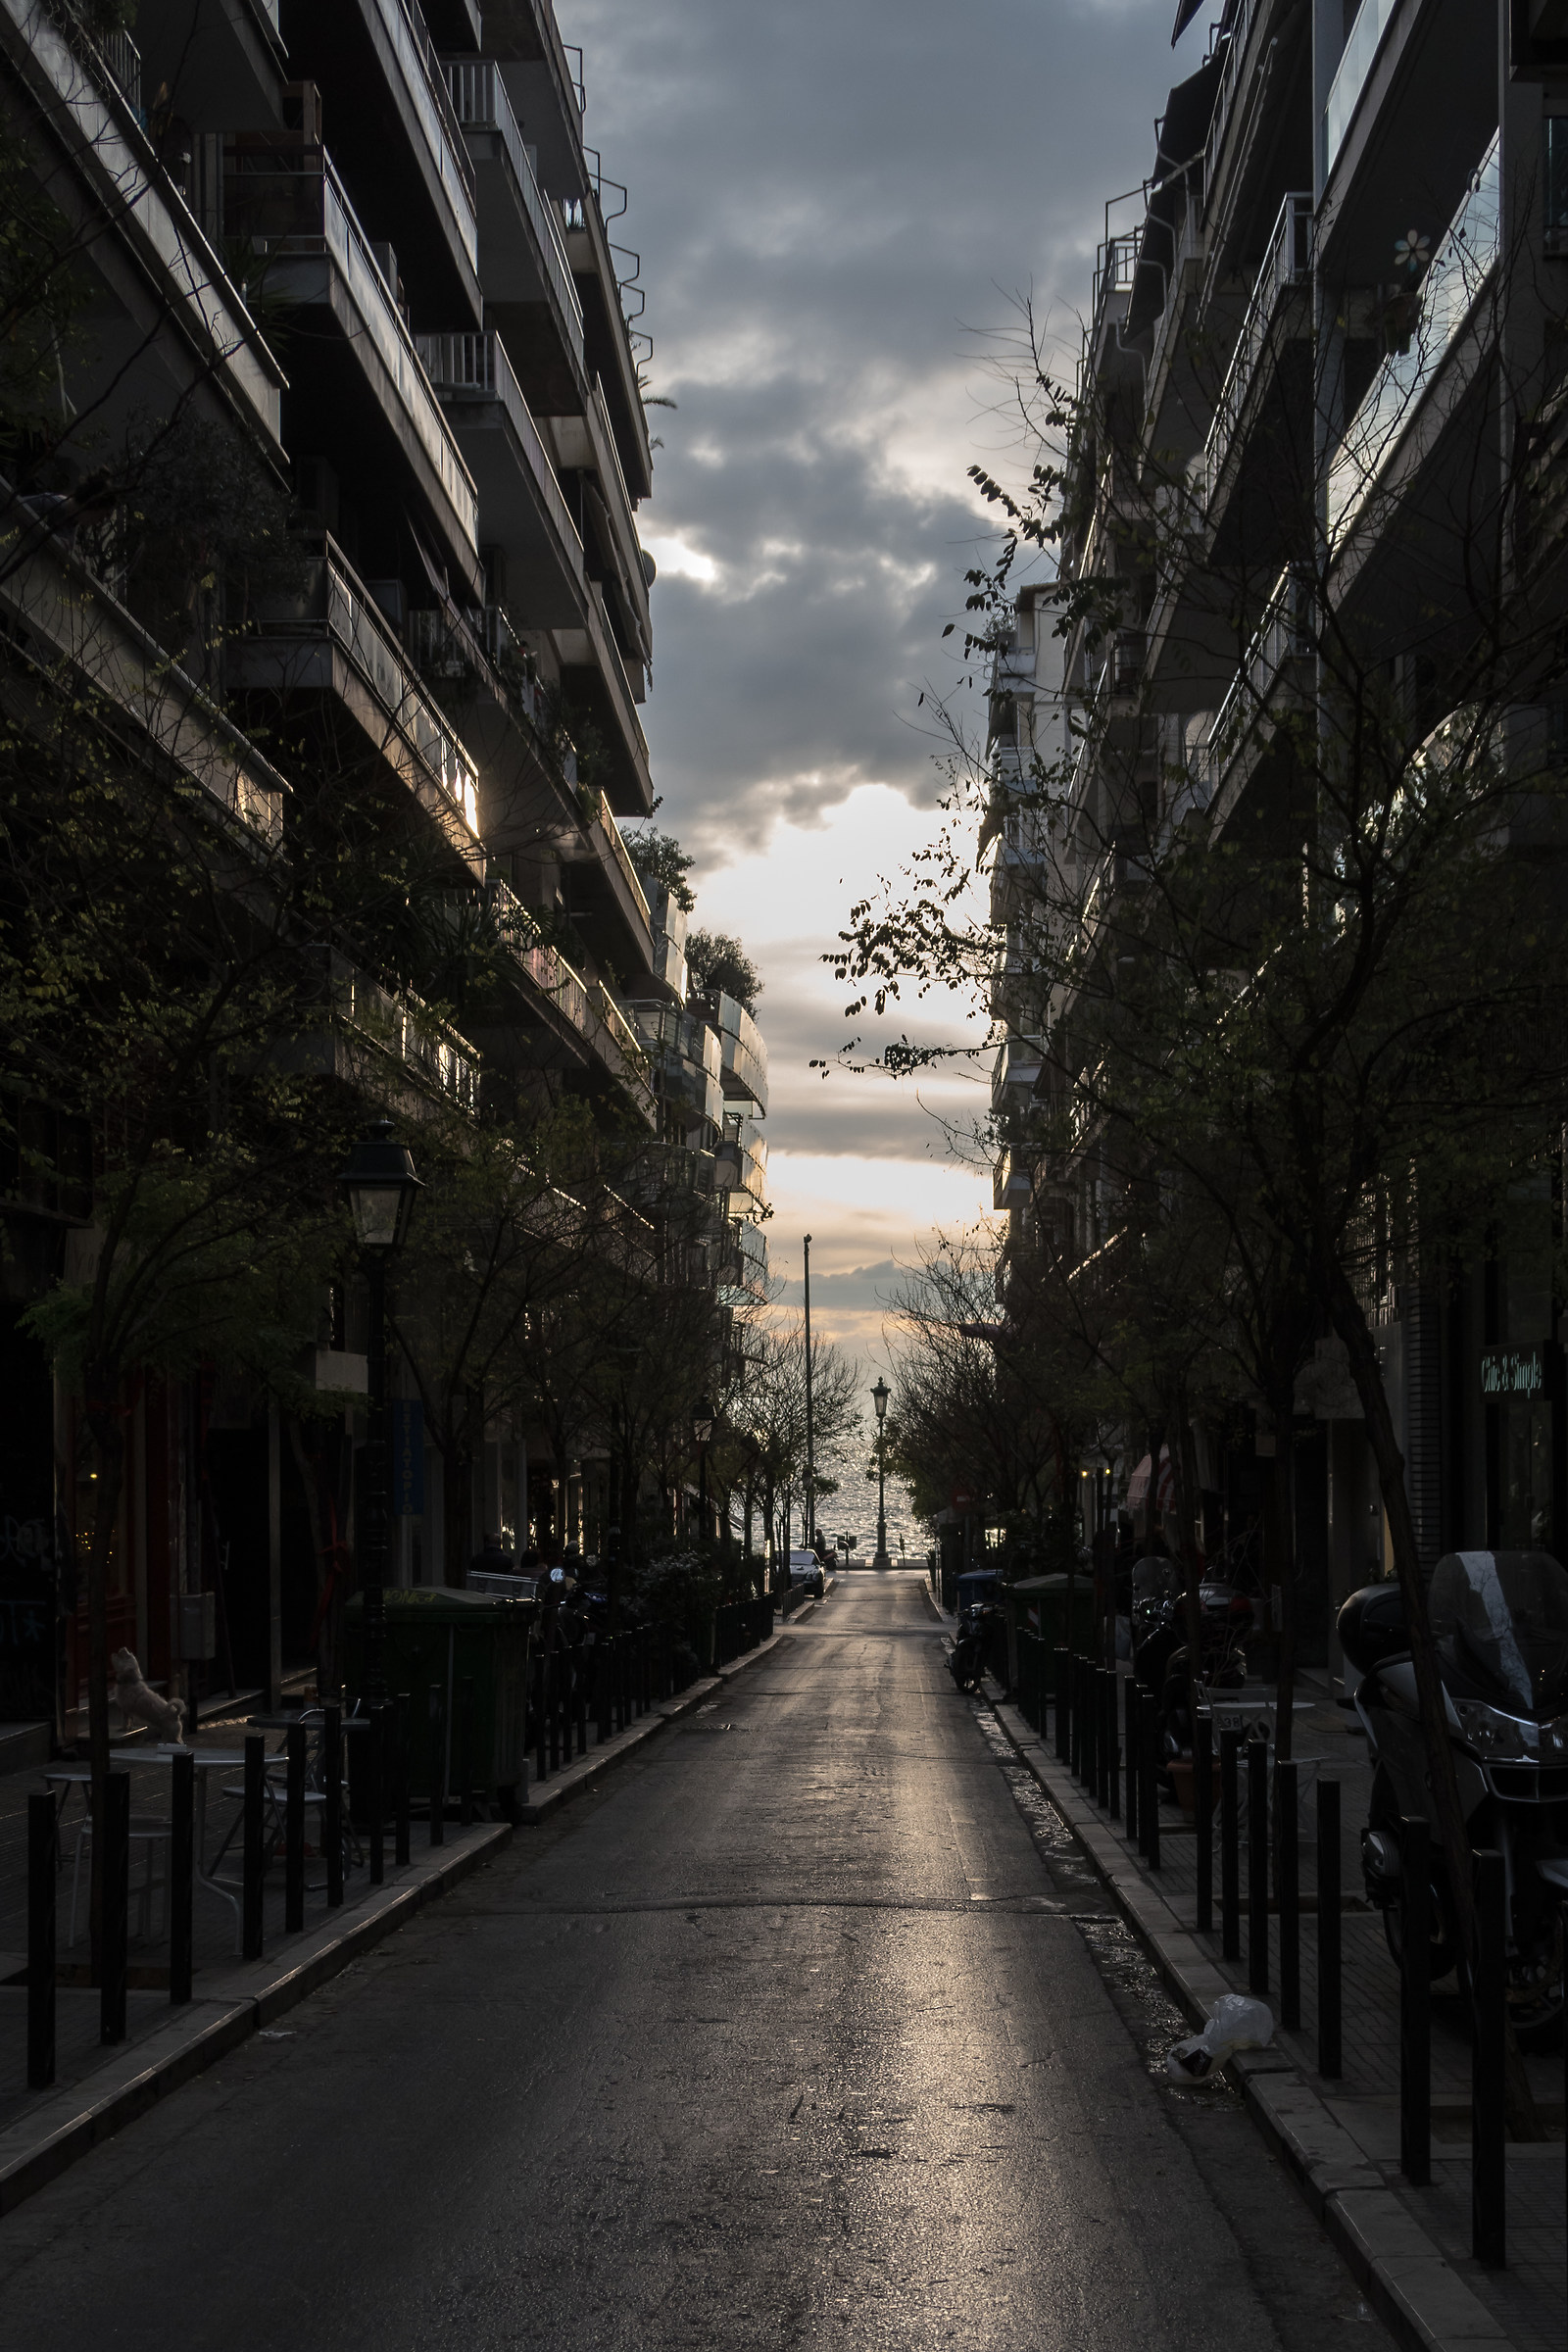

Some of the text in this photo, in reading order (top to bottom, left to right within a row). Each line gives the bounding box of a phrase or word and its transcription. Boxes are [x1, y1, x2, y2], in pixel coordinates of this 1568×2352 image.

[1481, 1350, 1542, 1399] Chic & Simple
